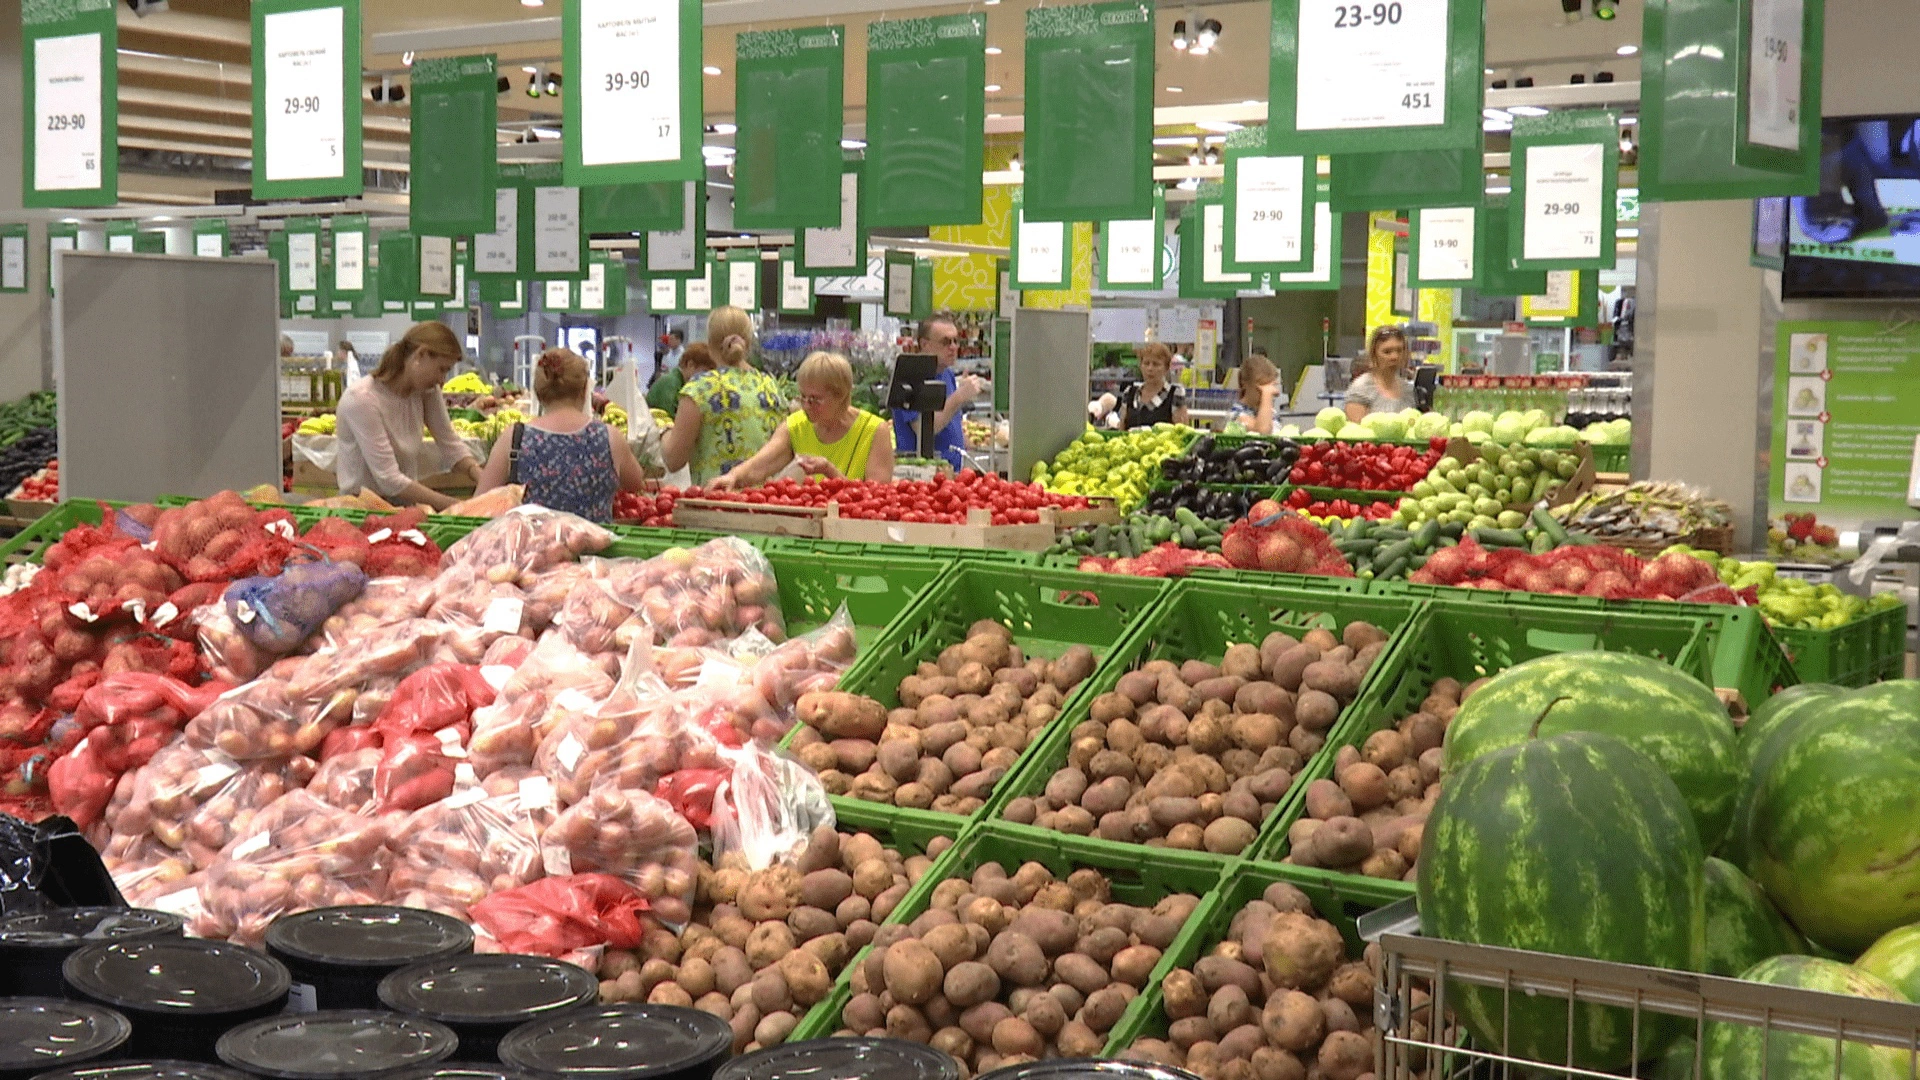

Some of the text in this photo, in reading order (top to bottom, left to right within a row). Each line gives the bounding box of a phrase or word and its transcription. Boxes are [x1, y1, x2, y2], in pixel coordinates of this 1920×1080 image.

[1334, 2, 1402, 28] 23-90
[605, 70, 650, 92] 39-90
[284, 96, 320, 114] 29-90
[1401, 93, 1431, 109] 451
[48, 114, 86, 131] 229-90
[658, 124, 670, 137] 17
[330, 145, 336, 156] 5
[85, 159, 95, 170] 65
[1543, 202, 1580, 215] 29-90
[1252, 210, 1283, 221] 29-90
[1286, 240, 1295, 248] 71
[1434, 239, 1458, 248] 19-90
[1583, 235, 1594, 244] 71
